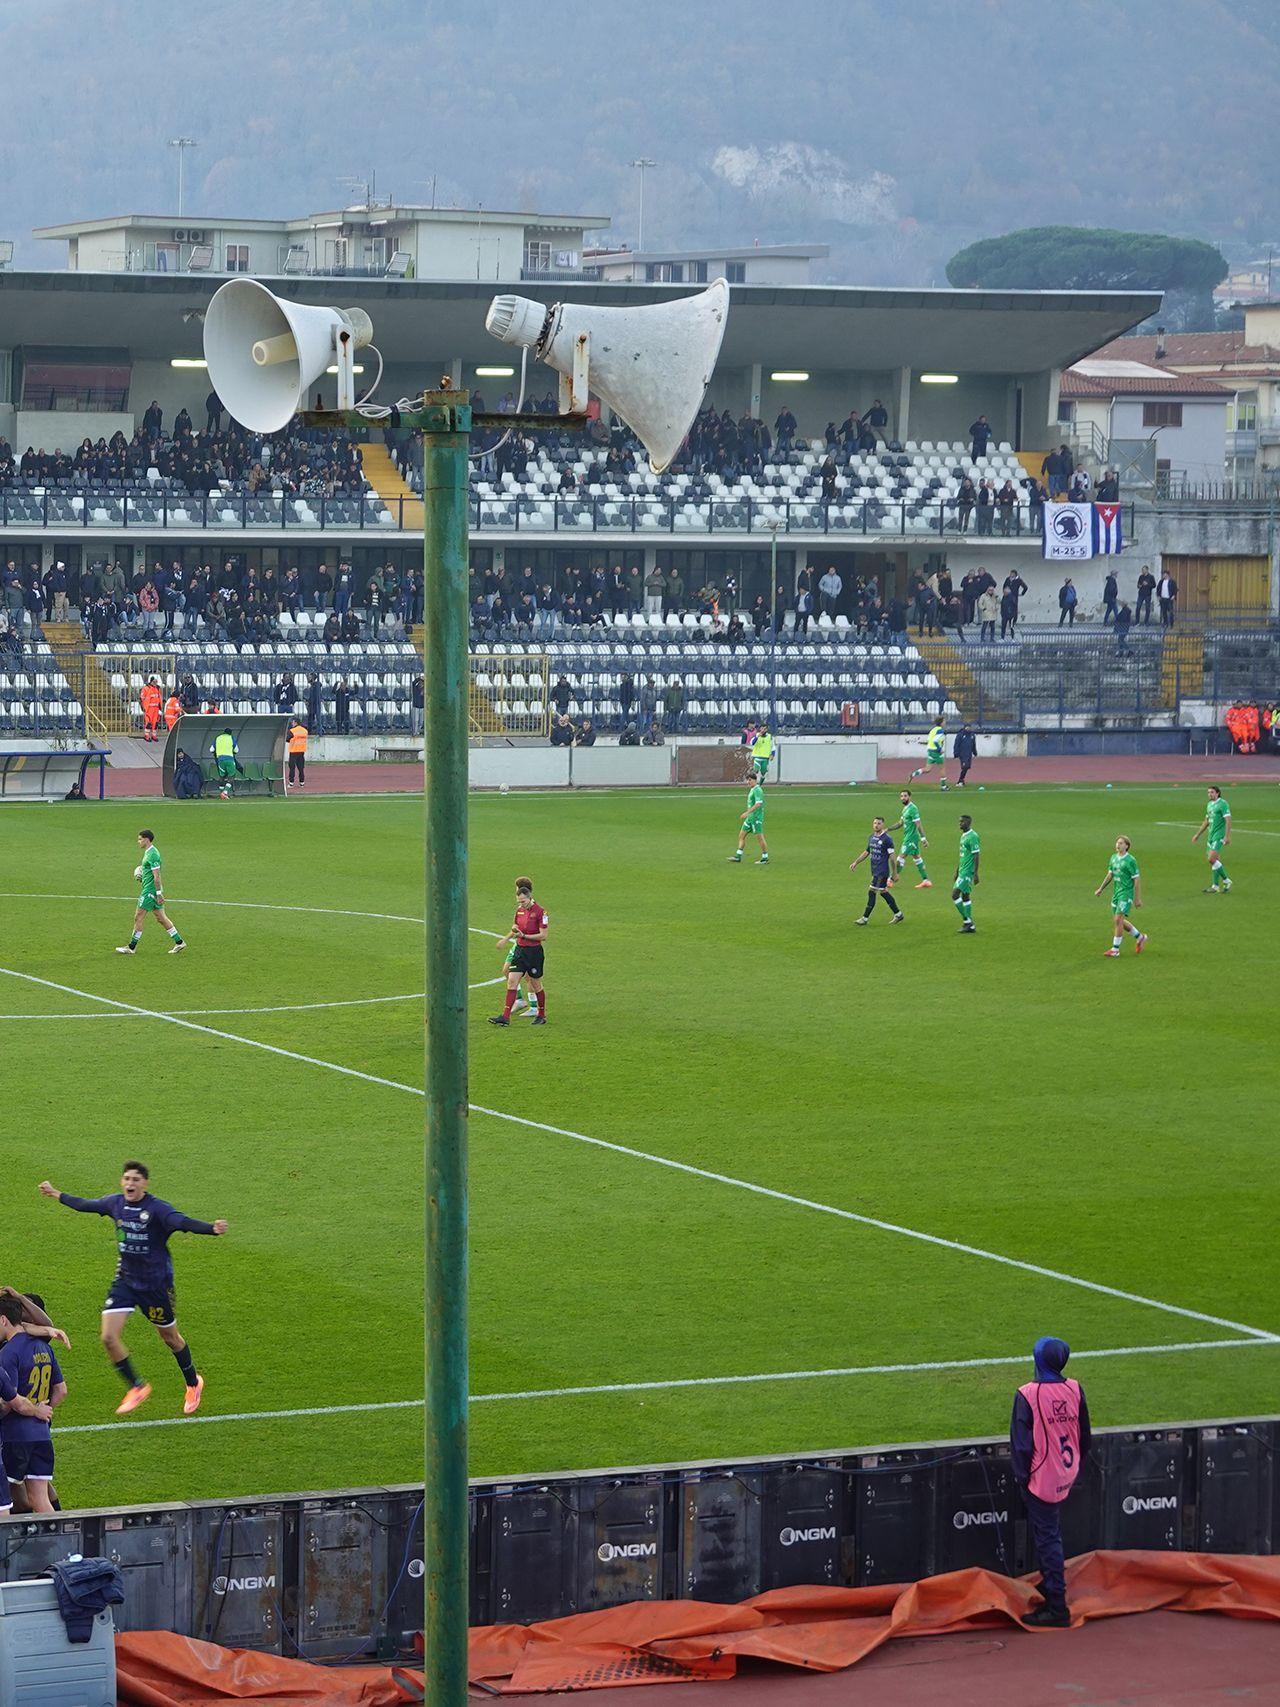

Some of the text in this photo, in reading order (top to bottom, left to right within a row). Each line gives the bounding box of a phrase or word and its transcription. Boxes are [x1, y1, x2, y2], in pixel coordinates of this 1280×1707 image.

[148, 1306, 165, 1320] 82
[26, 1364, 53, 1404] 28
[1059, 1435, 1074, 1469] 5
[1138, 1496, 1177, 1510] NGM
[968, 1510, 1008, 1525] NGM
[795, 1526, 836, 1542] NGM
[613, 1543, 657, 1558] NGM
[230, 1575, 276, 1591] NGM
